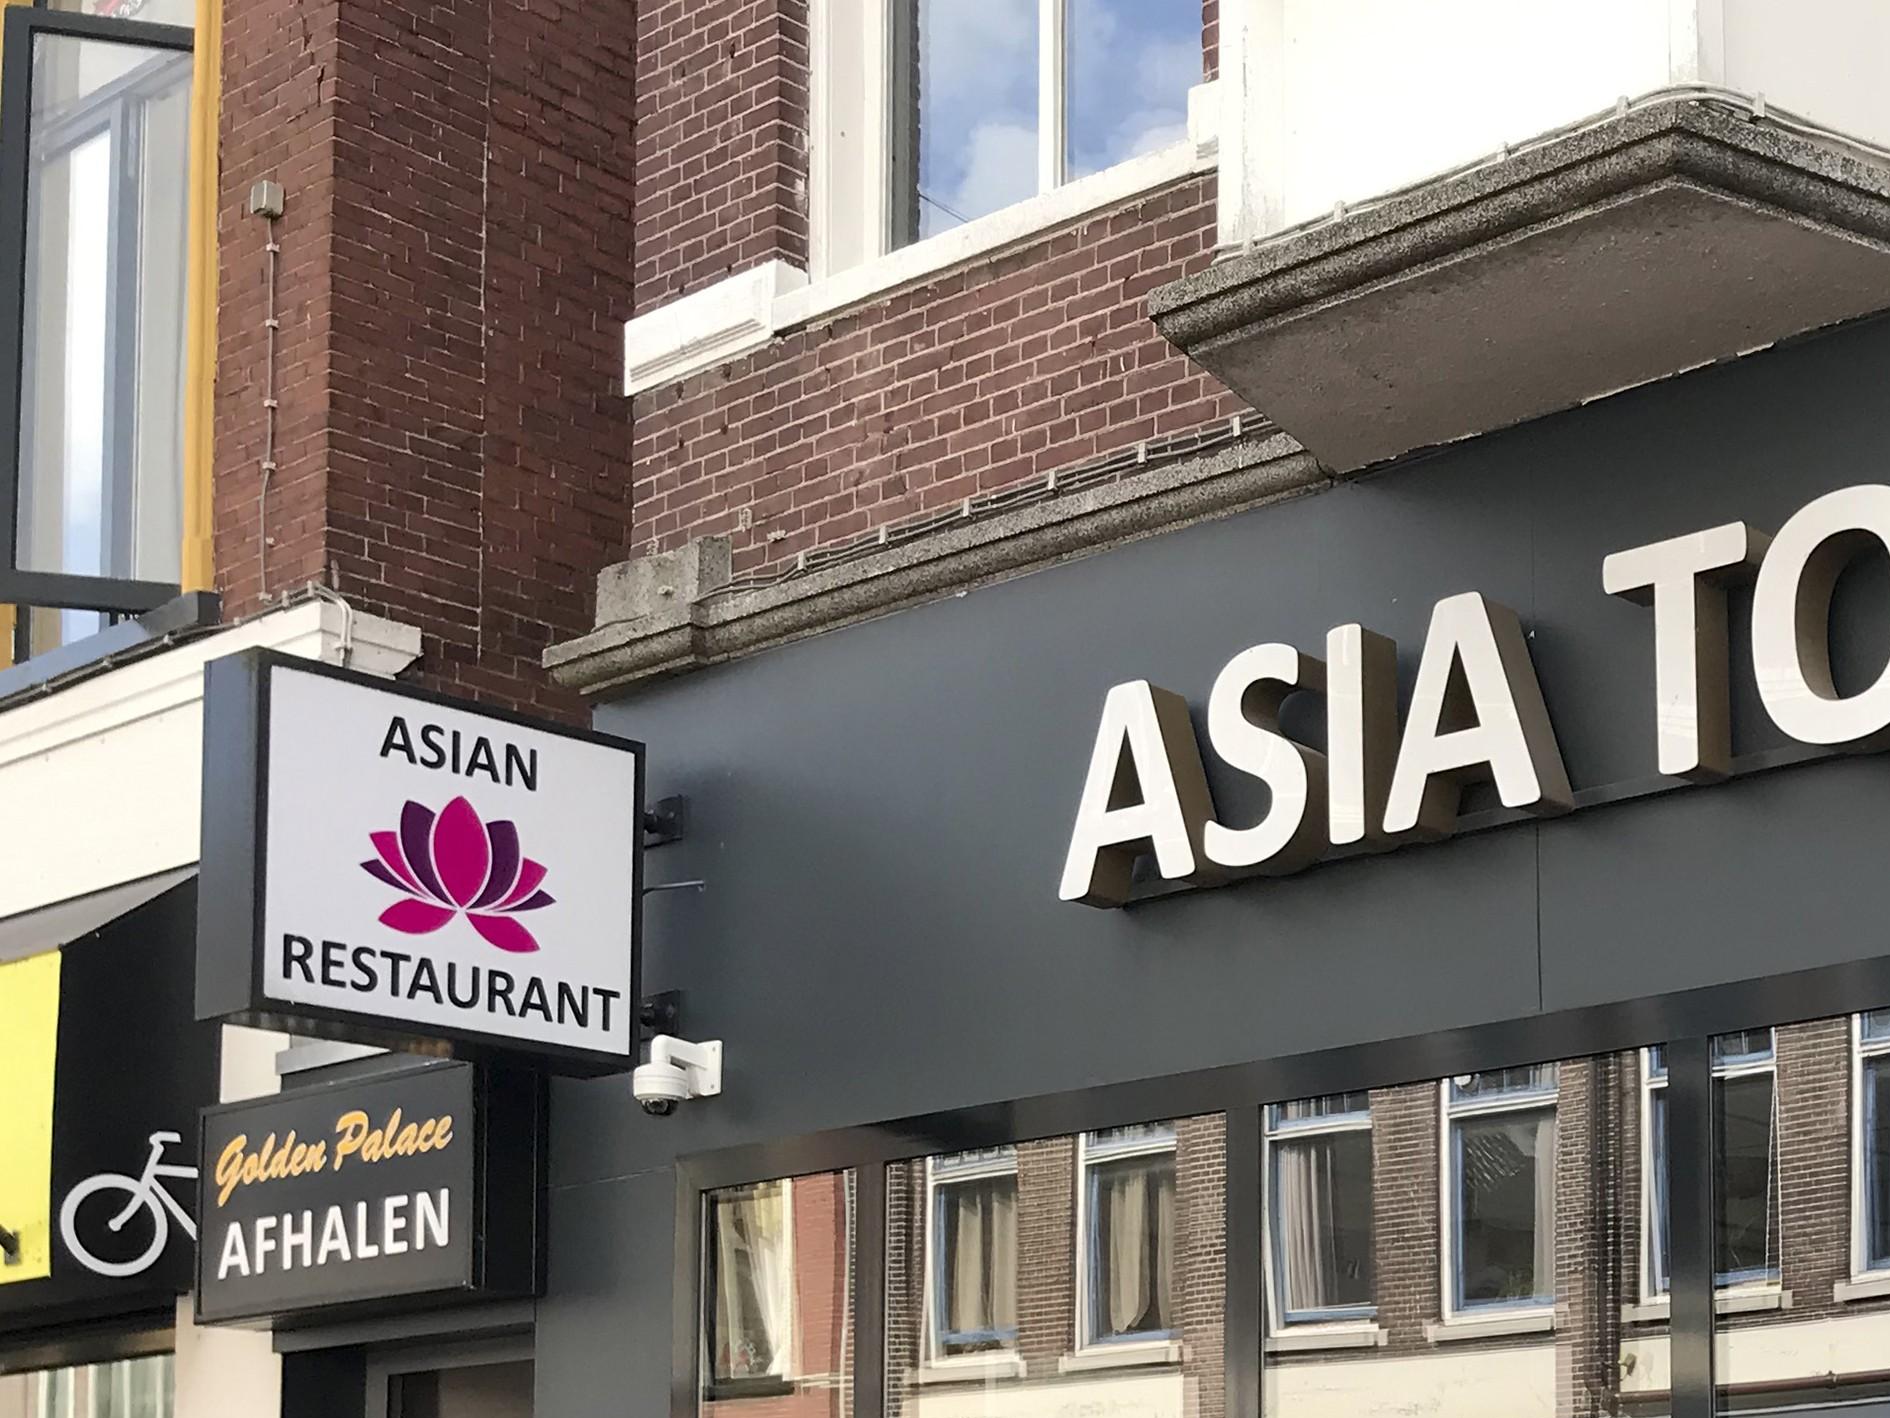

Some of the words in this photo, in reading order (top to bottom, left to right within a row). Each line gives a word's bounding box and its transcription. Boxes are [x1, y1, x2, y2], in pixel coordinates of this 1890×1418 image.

[380, 716, 538, 791] ASIAN
[1056, 588, 1558, 904] ASIA
[282, 934, 621, 1033] RESTAURANT
[215, 1129, 327, 1207] Golden
[333, 1108, 454, 1172] Palace
[217, 1188, 450, 1280] AFHALEN
